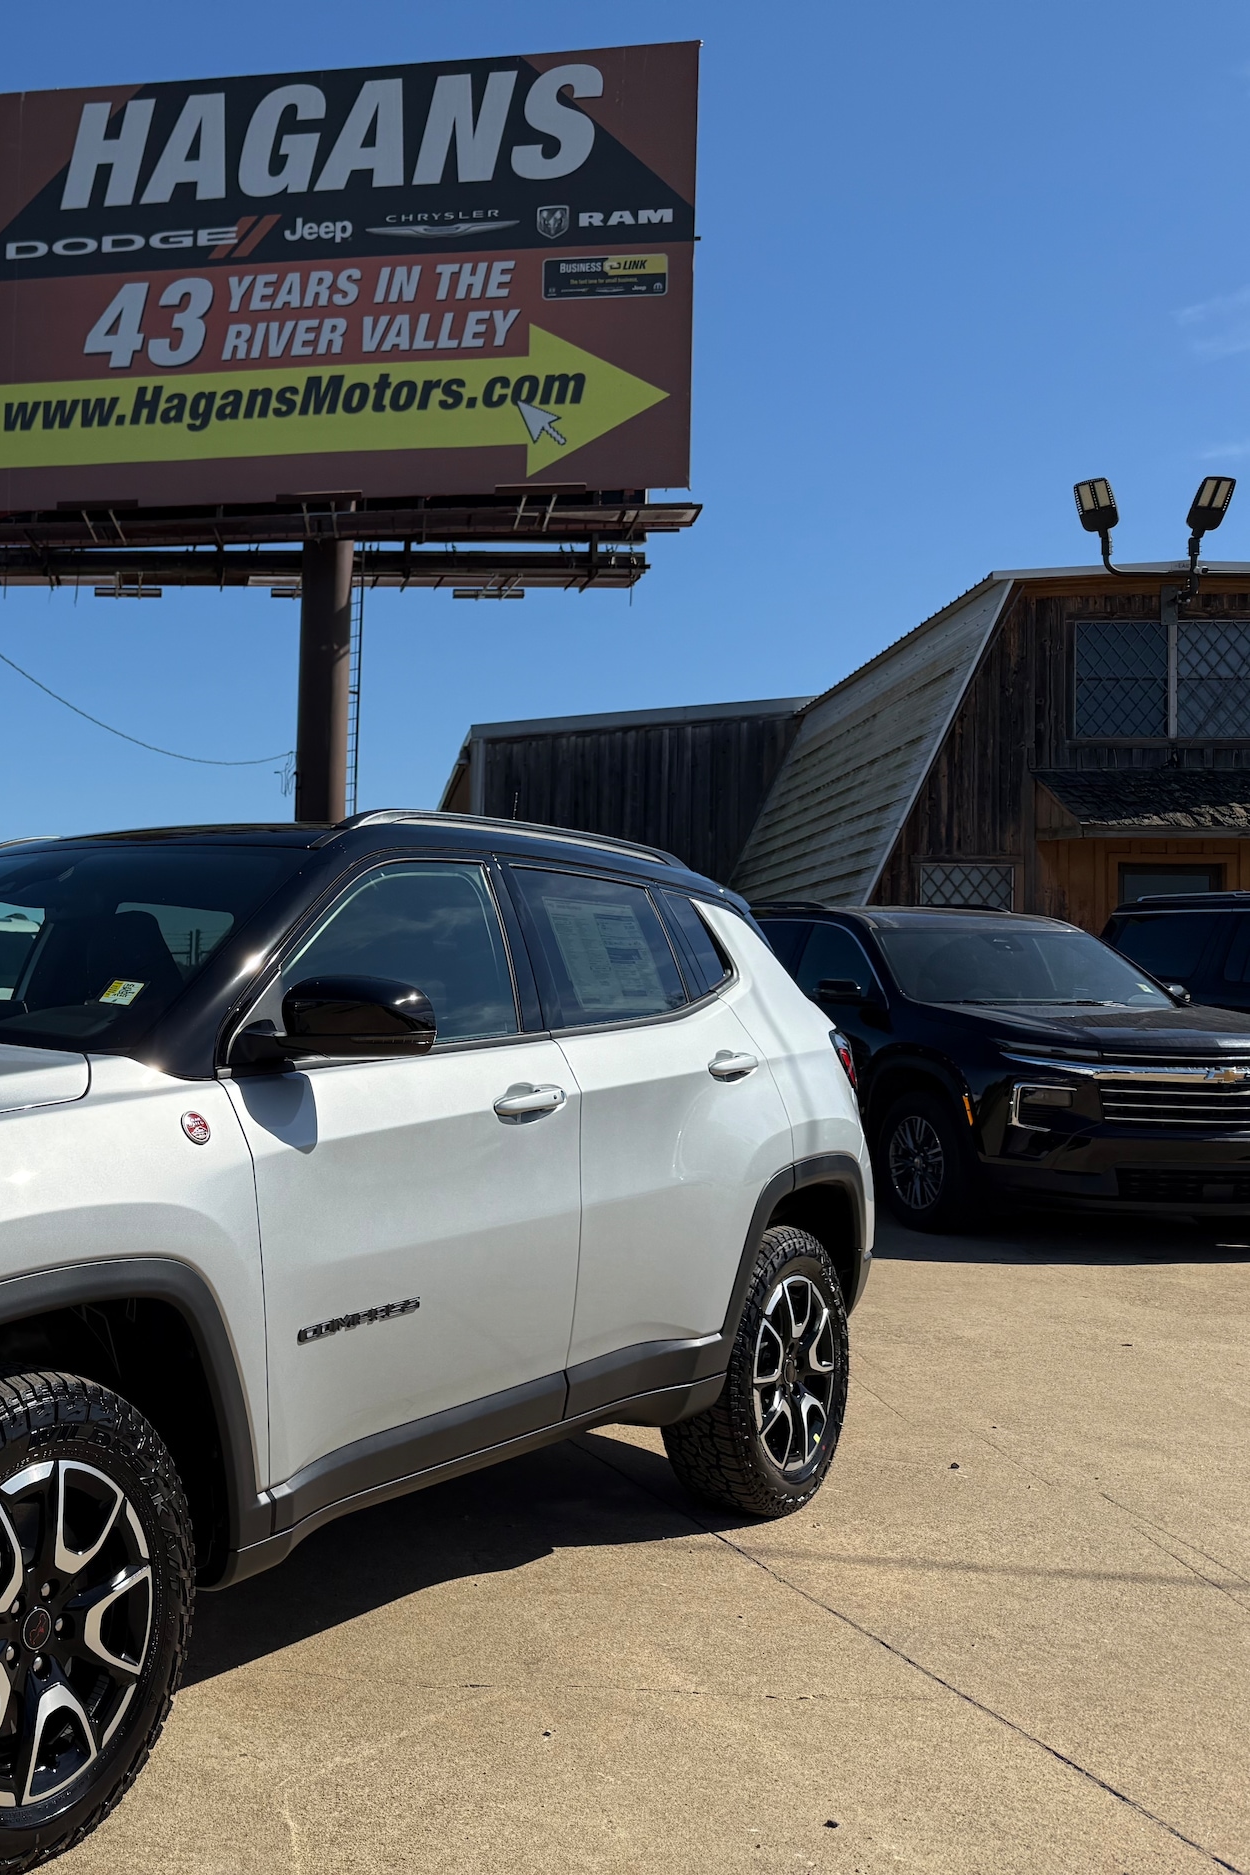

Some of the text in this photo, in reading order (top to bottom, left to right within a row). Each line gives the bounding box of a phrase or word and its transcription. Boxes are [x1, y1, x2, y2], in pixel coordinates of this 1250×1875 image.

[60, 64, 605, 210] HAGANS
[284, 217, 353, 243] Jeep
[385, 208, 500, 223] CHRYSLER
[578, 208, 674, 227] RAM
[6, 226, 238, 260] DODGE
[559, 260, 648, 273] BUSINESS LINK
[228, 261, 516, 312] YEARS IN THE
[83, 277, 214, 369] 43
[221, 308, 521, 361] RIVER VALLEY
[3, 372, 586, 432] www.HagansMotors.com
[297, 1296, 420, 1343] COMPASS
